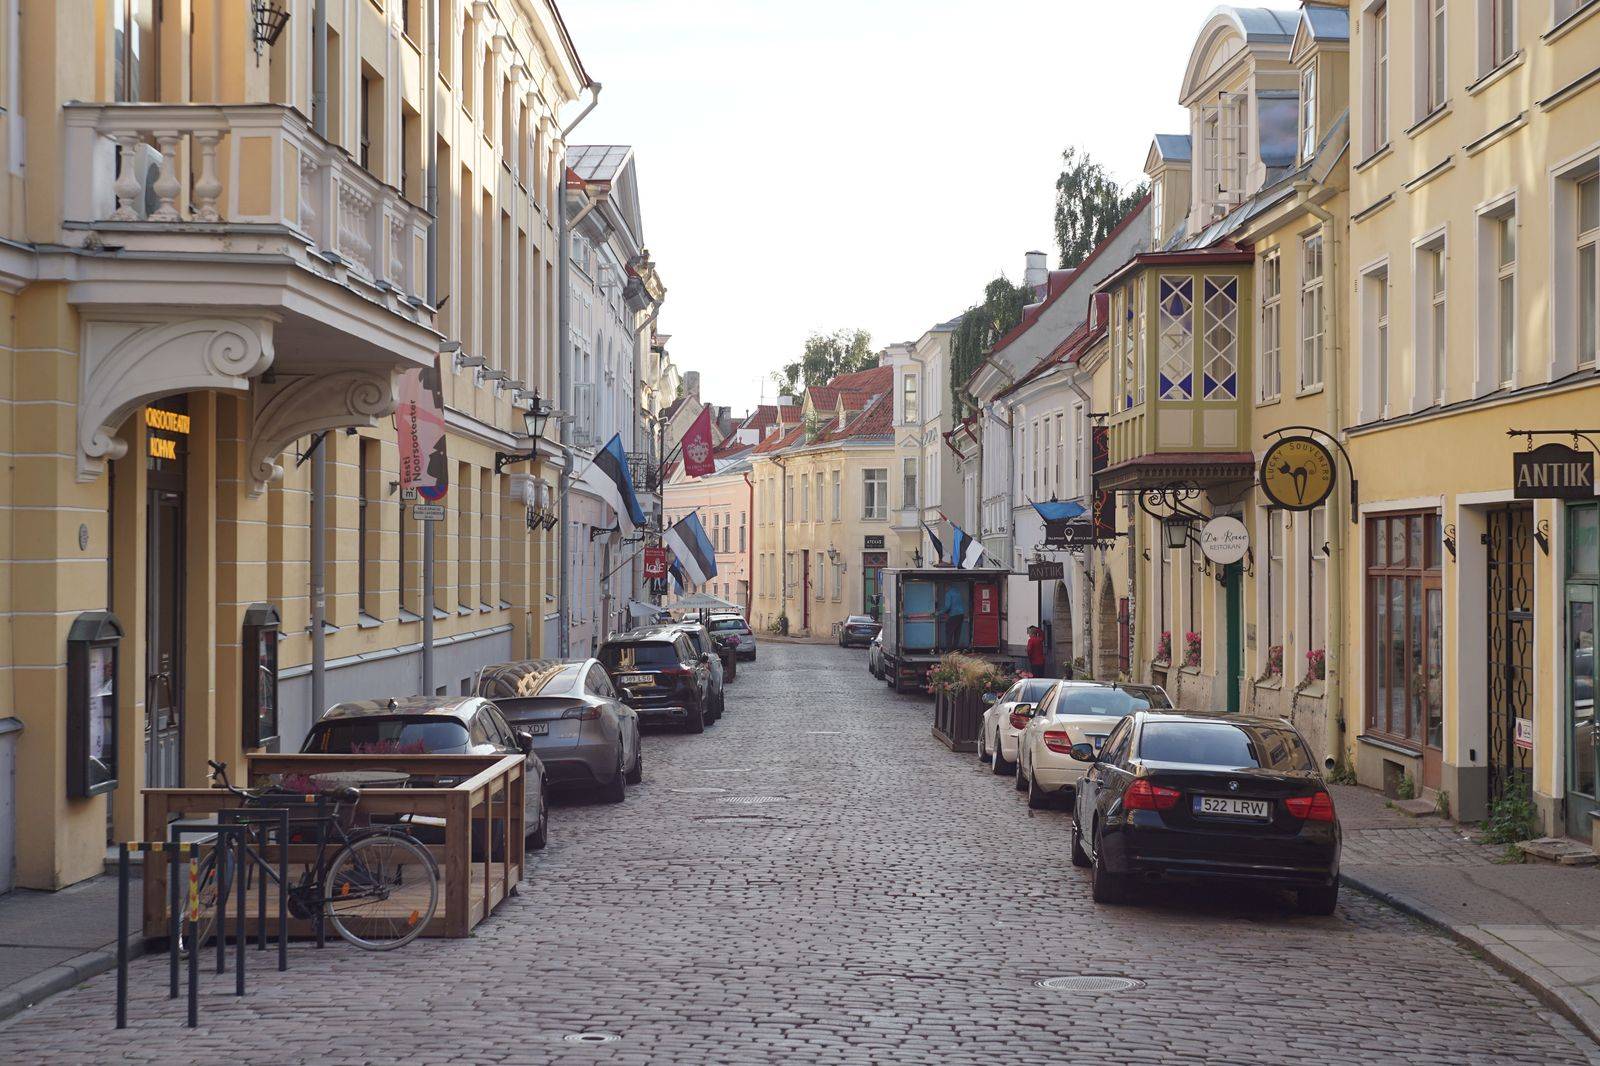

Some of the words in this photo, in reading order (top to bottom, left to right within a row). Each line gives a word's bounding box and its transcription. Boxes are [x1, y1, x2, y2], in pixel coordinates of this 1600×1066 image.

[410, 400, 422, 481] Noorsooteater
[403, 456, 411, 484] Eesti
[1267, 449, 1283, 480] LUCKY
[1289, 442, 1330, 481] SOUVENIRS
[1517, 462, 1591, 487] ANTIIK
[1032, 565, 1063, 578] ANTIIK
[527, 724, 546, 733] XDY
[1204, 799, 1228, 812] 522
[1233, 801, 1265, 815] LRW
